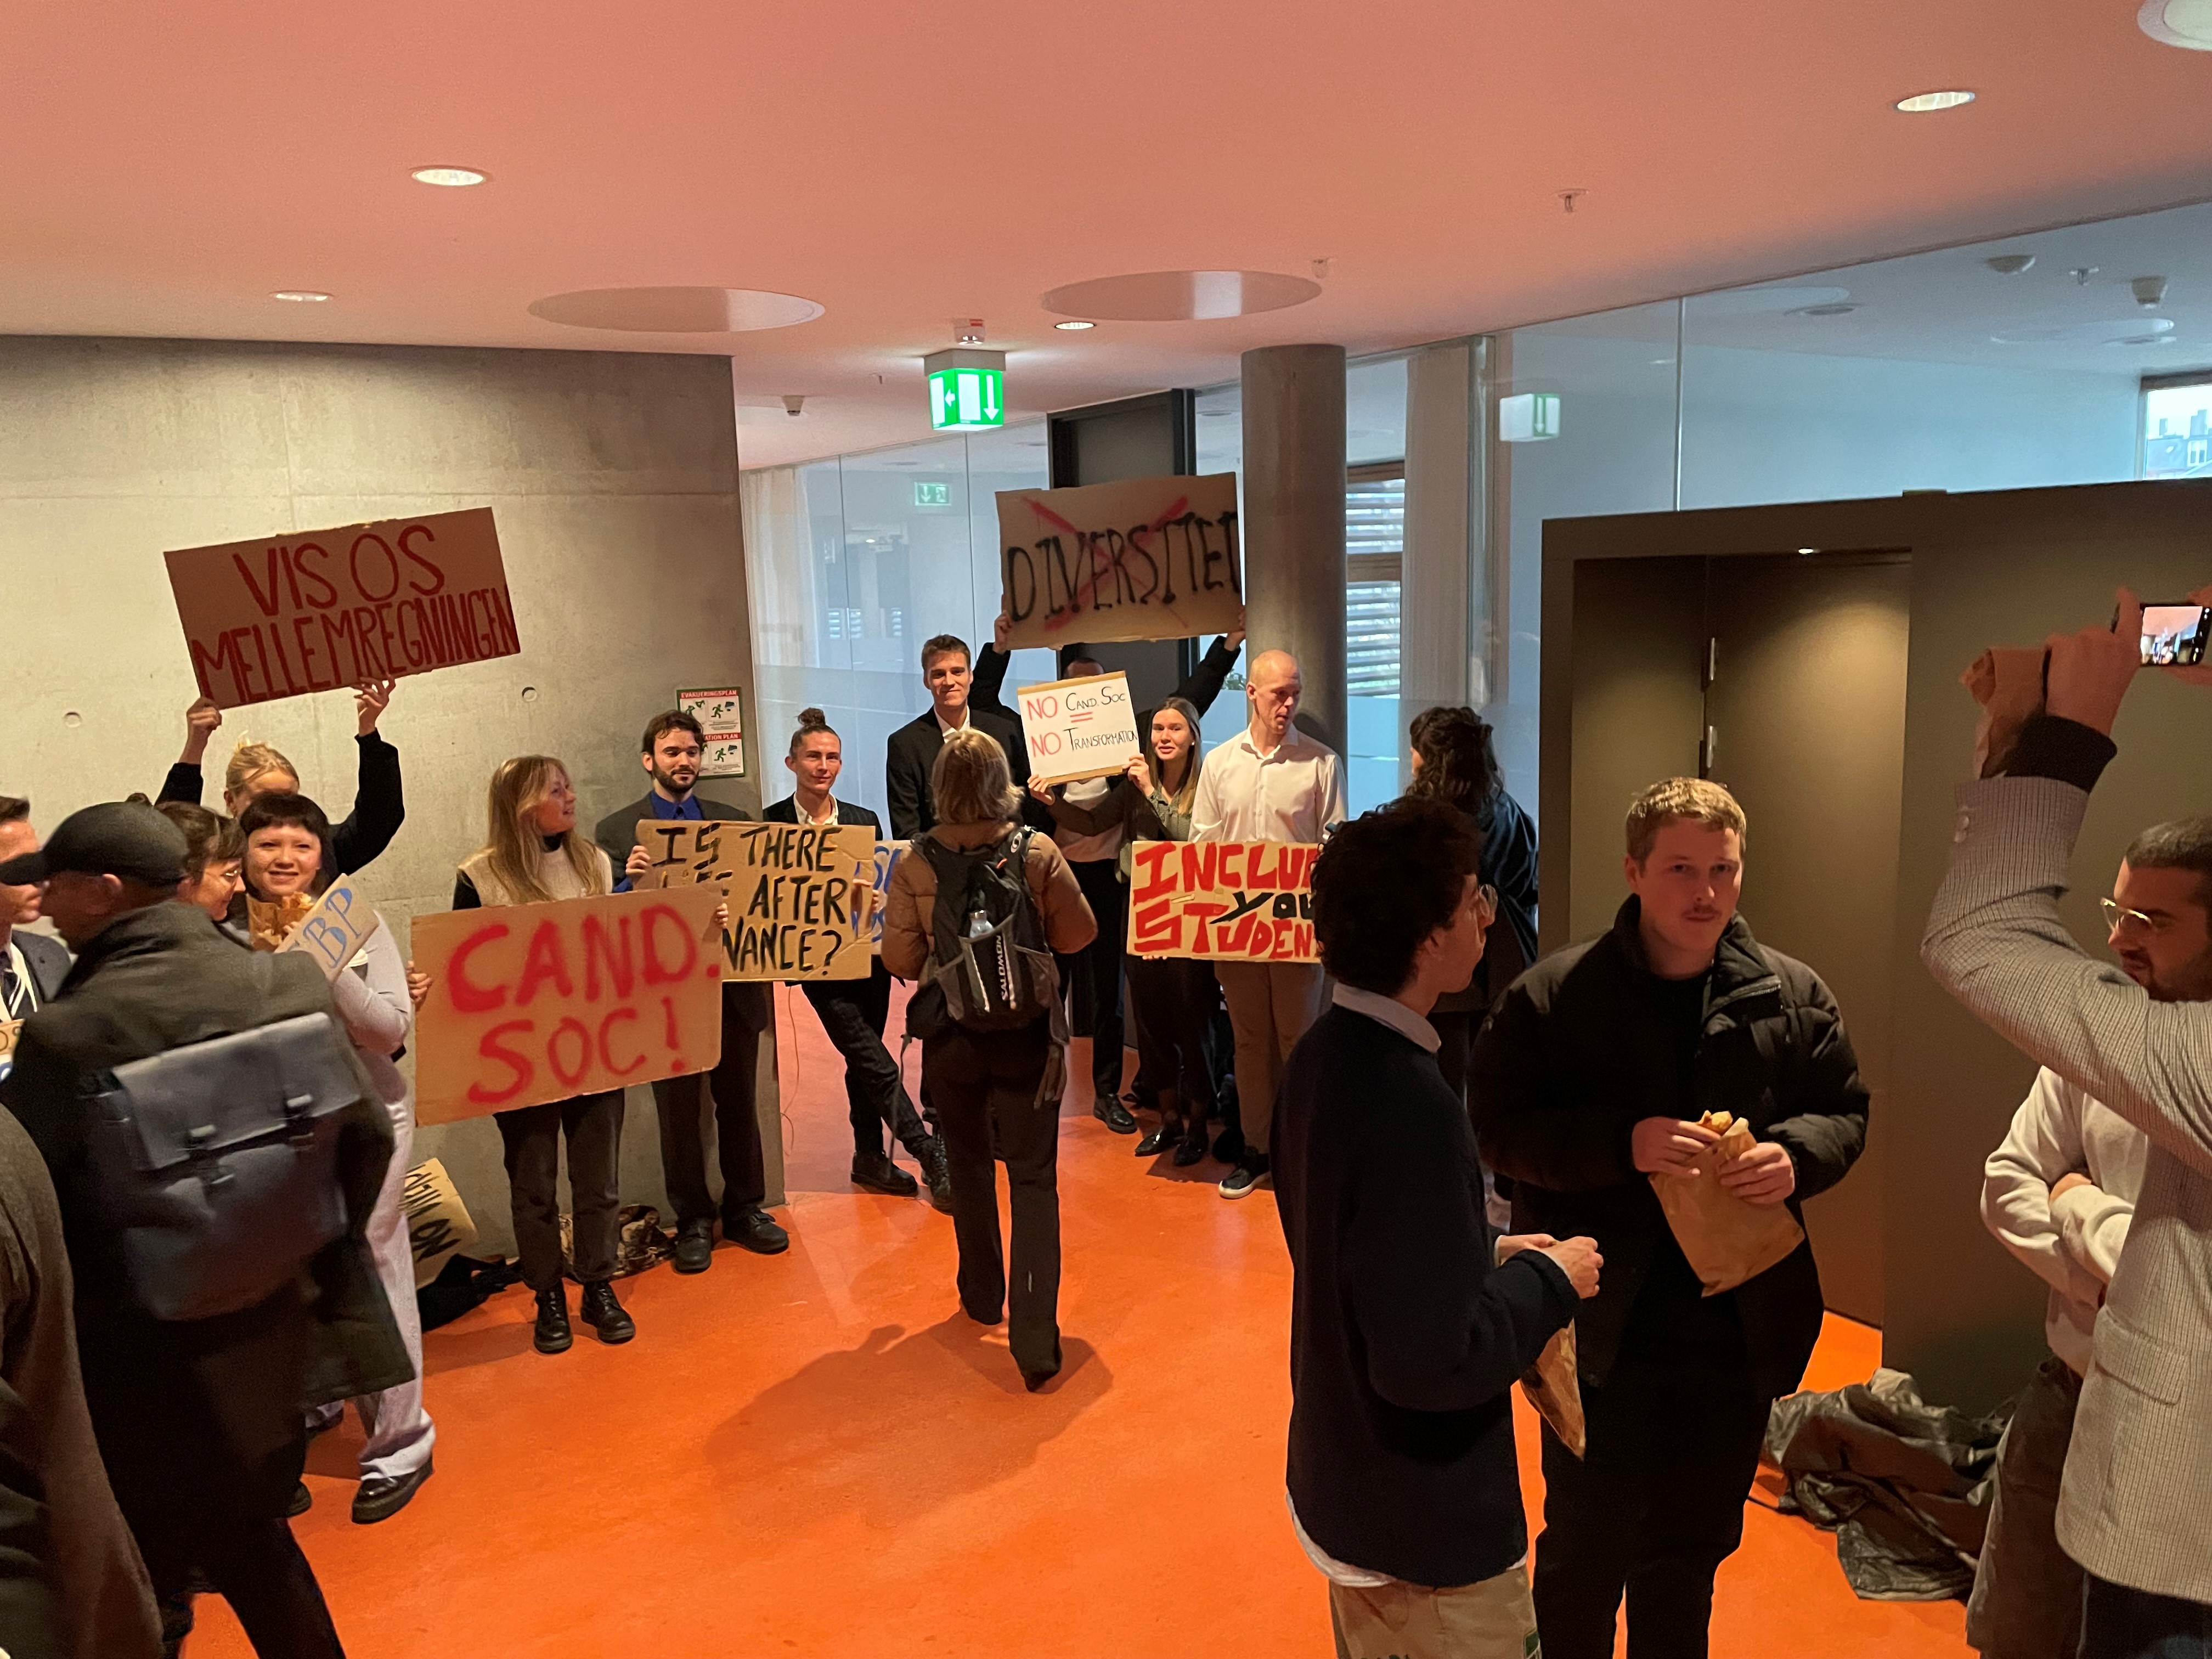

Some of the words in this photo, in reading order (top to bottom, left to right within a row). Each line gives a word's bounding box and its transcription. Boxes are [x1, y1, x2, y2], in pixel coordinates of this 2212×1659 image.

[233, 543, 337, 616] VIS
[349, 524, 445, 602] OS
[192, 585, 521, 704] MELLEMREGNINGEN
[1026, 696, 1058, 721] NO
[1031, 732, 1062, 758] NO
[652, 822, 721, 871] IS
[739, 825, 843, 872] THERE
[287, 887, 360, 968] BP
[747, 873, 848, 926] AFTER
[1134, 898, 1318, 959] STUDEN
[446, 903, 720, 1013] CAND.
[996, 935, 1008, 1001] SALOMON
[467, 995, 686, 1103] SOC!
